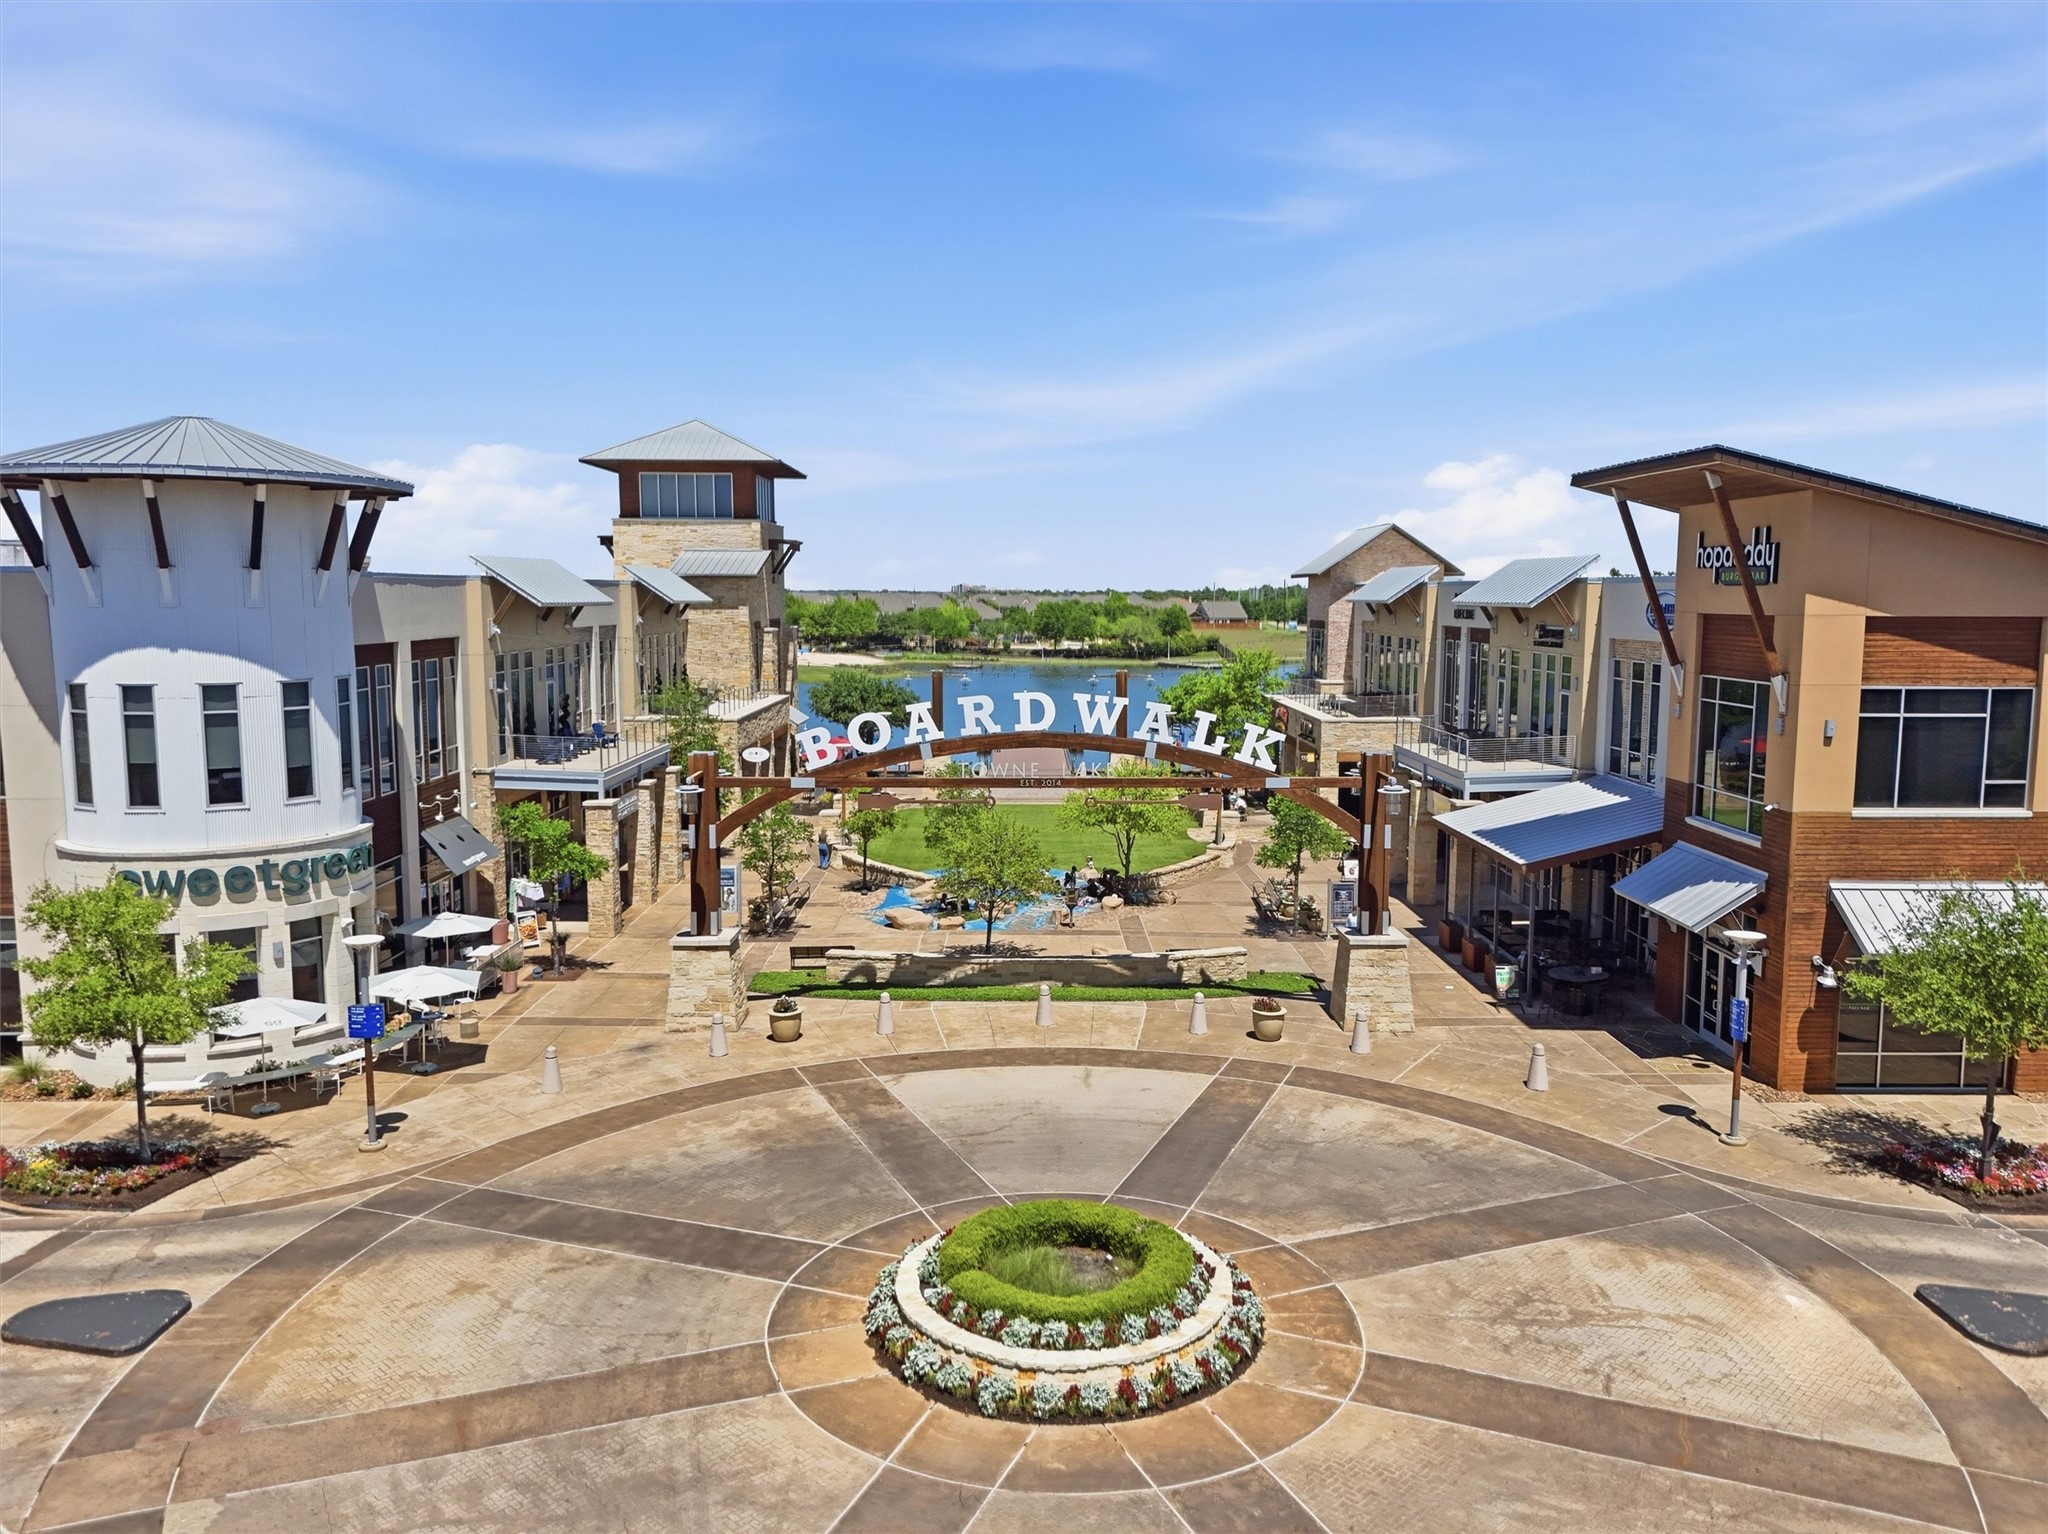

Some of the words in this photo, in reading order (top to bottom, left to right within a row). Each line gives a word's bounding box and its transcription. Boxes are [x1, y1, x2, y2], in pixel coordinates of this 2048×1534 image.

[795, 690, 1287, 772] BOARDWALK
[957, 762, 1040, 779] TOWNE
[1062, 762, 1112, 779] LAKE
[1020, 779, 1038, 787] EST.
[1041, 779, 1062, 787] 2014
